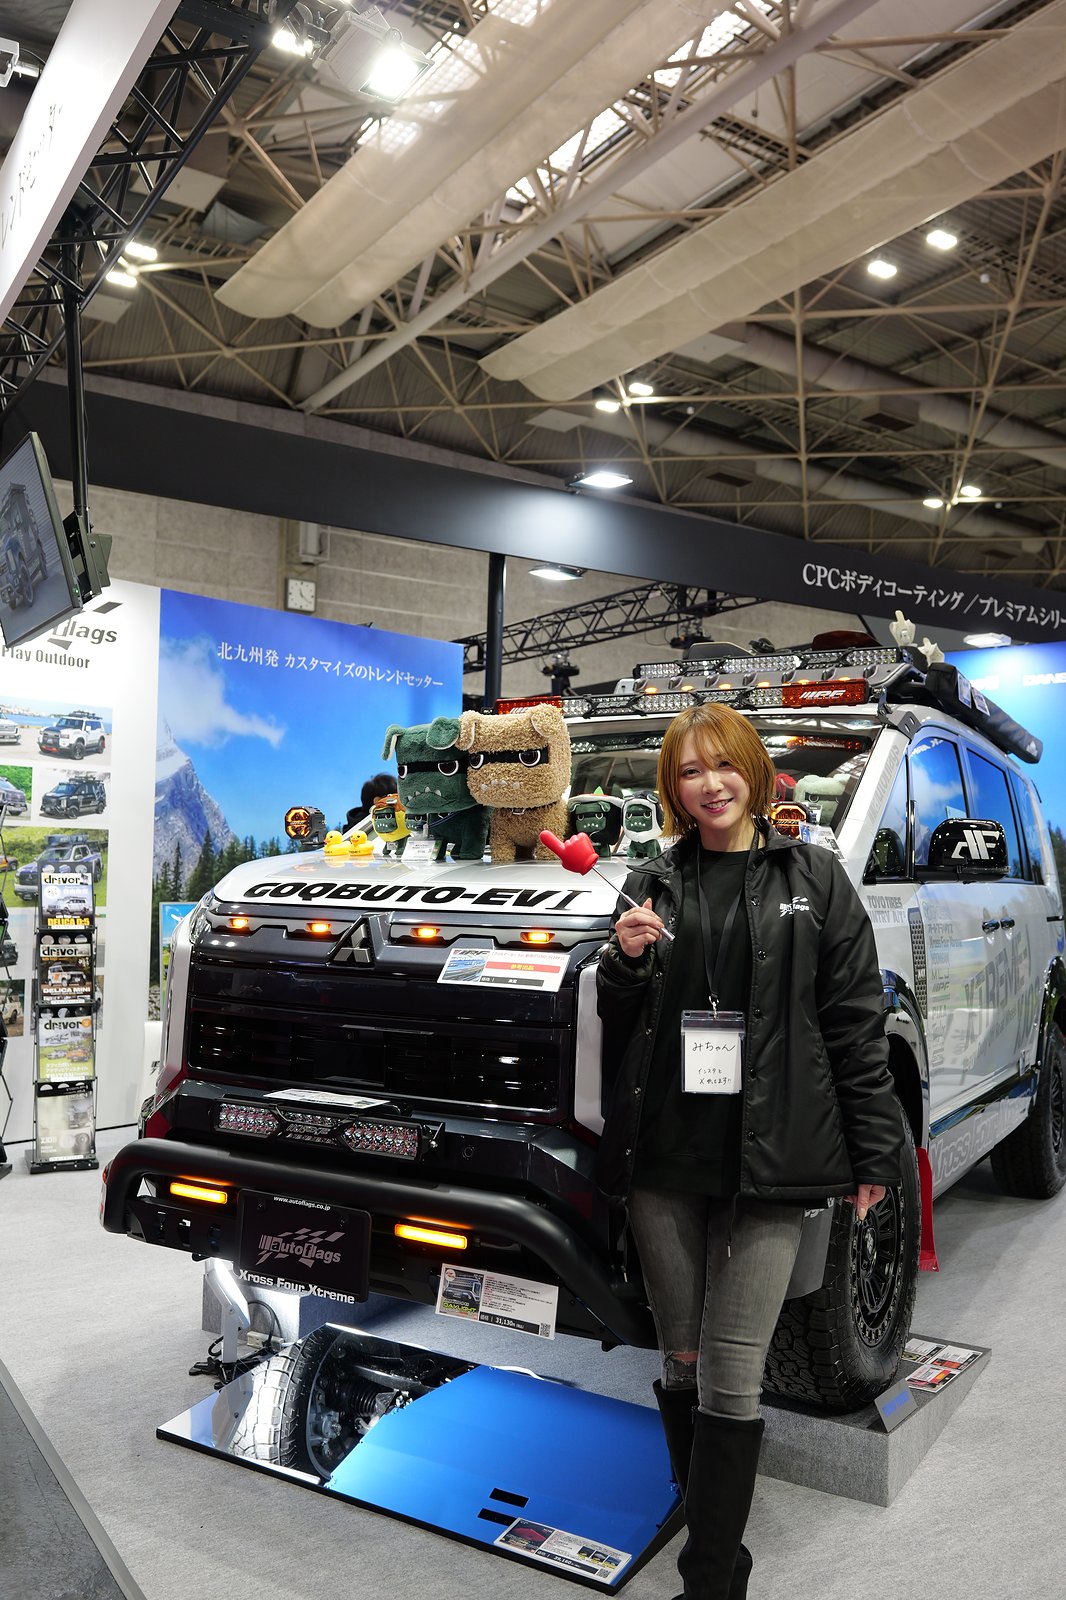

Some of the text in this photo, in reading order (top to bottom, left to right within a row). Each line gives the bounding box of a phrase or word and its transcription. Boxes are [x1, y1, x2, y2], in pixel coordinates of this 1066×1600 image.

[2, 645, 90, 668] Play Outdoor
[217, 642, 444, 688] 北九州発 カスタマイズのトレンドセッター
[44, 875, 80, 884] driver
[43, 946, 78, 956] driver
[44, 1020, 82, 1030] driver
[692, 1042, 736, 1051] みちゃん
[273, 1194, 331, 1211] www.autoflags.co.jp
[270, 1236, 342, 1264] autoflags
[239, 1268, 356, 1305] Xross Four Xtreme
